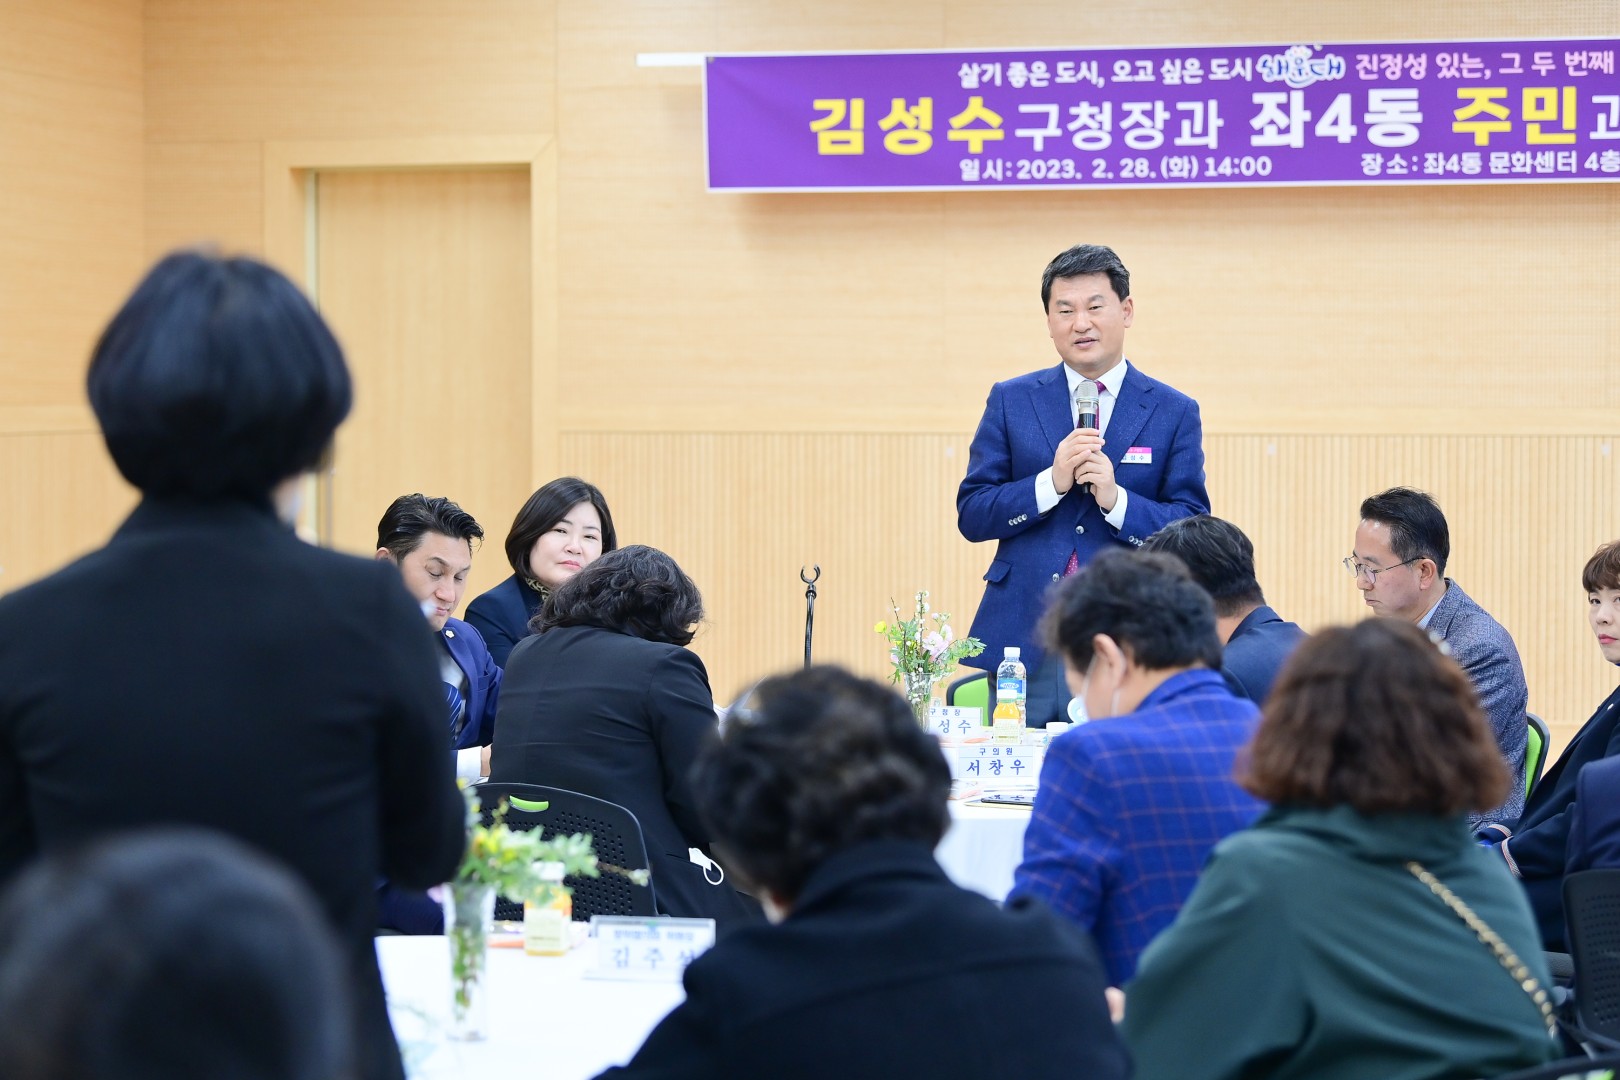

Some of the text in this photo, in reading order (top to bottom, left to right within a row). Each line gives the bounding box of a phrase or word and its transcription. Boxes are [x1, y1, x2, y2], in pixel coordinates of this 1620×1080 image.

[959, 62, 1002, 88] 살기
[1006, 61, 1051, 88] 좋은
[1055, 60, 1105, 88] 도시,
[1111, 59, 1156, 83] 오고
[1160, 58, 1205, 84] 싶은
[1208, 57, 1253, 82] 도시
[1355, 53, 1427, 80] 진정성
[1435, 52, 1492, 79] 있는,
[1499, 52, 1524, 74] 그
[1531, 52, 1556, 77] 두
[1564, 50, 1614, 77] 번째
[1249, 87, 1424, 149] 좌4동
[1204, 155, 1273, 178] 14:00
[1423, 151, 1483, 175] 좌4동
[1488, 150, 1577, 175] 문화센터
[1583, 149, 1620, 173] 4층
[979, 747, 1013, 756] 구의원
[966, 758, 1026, 777] 서창우
